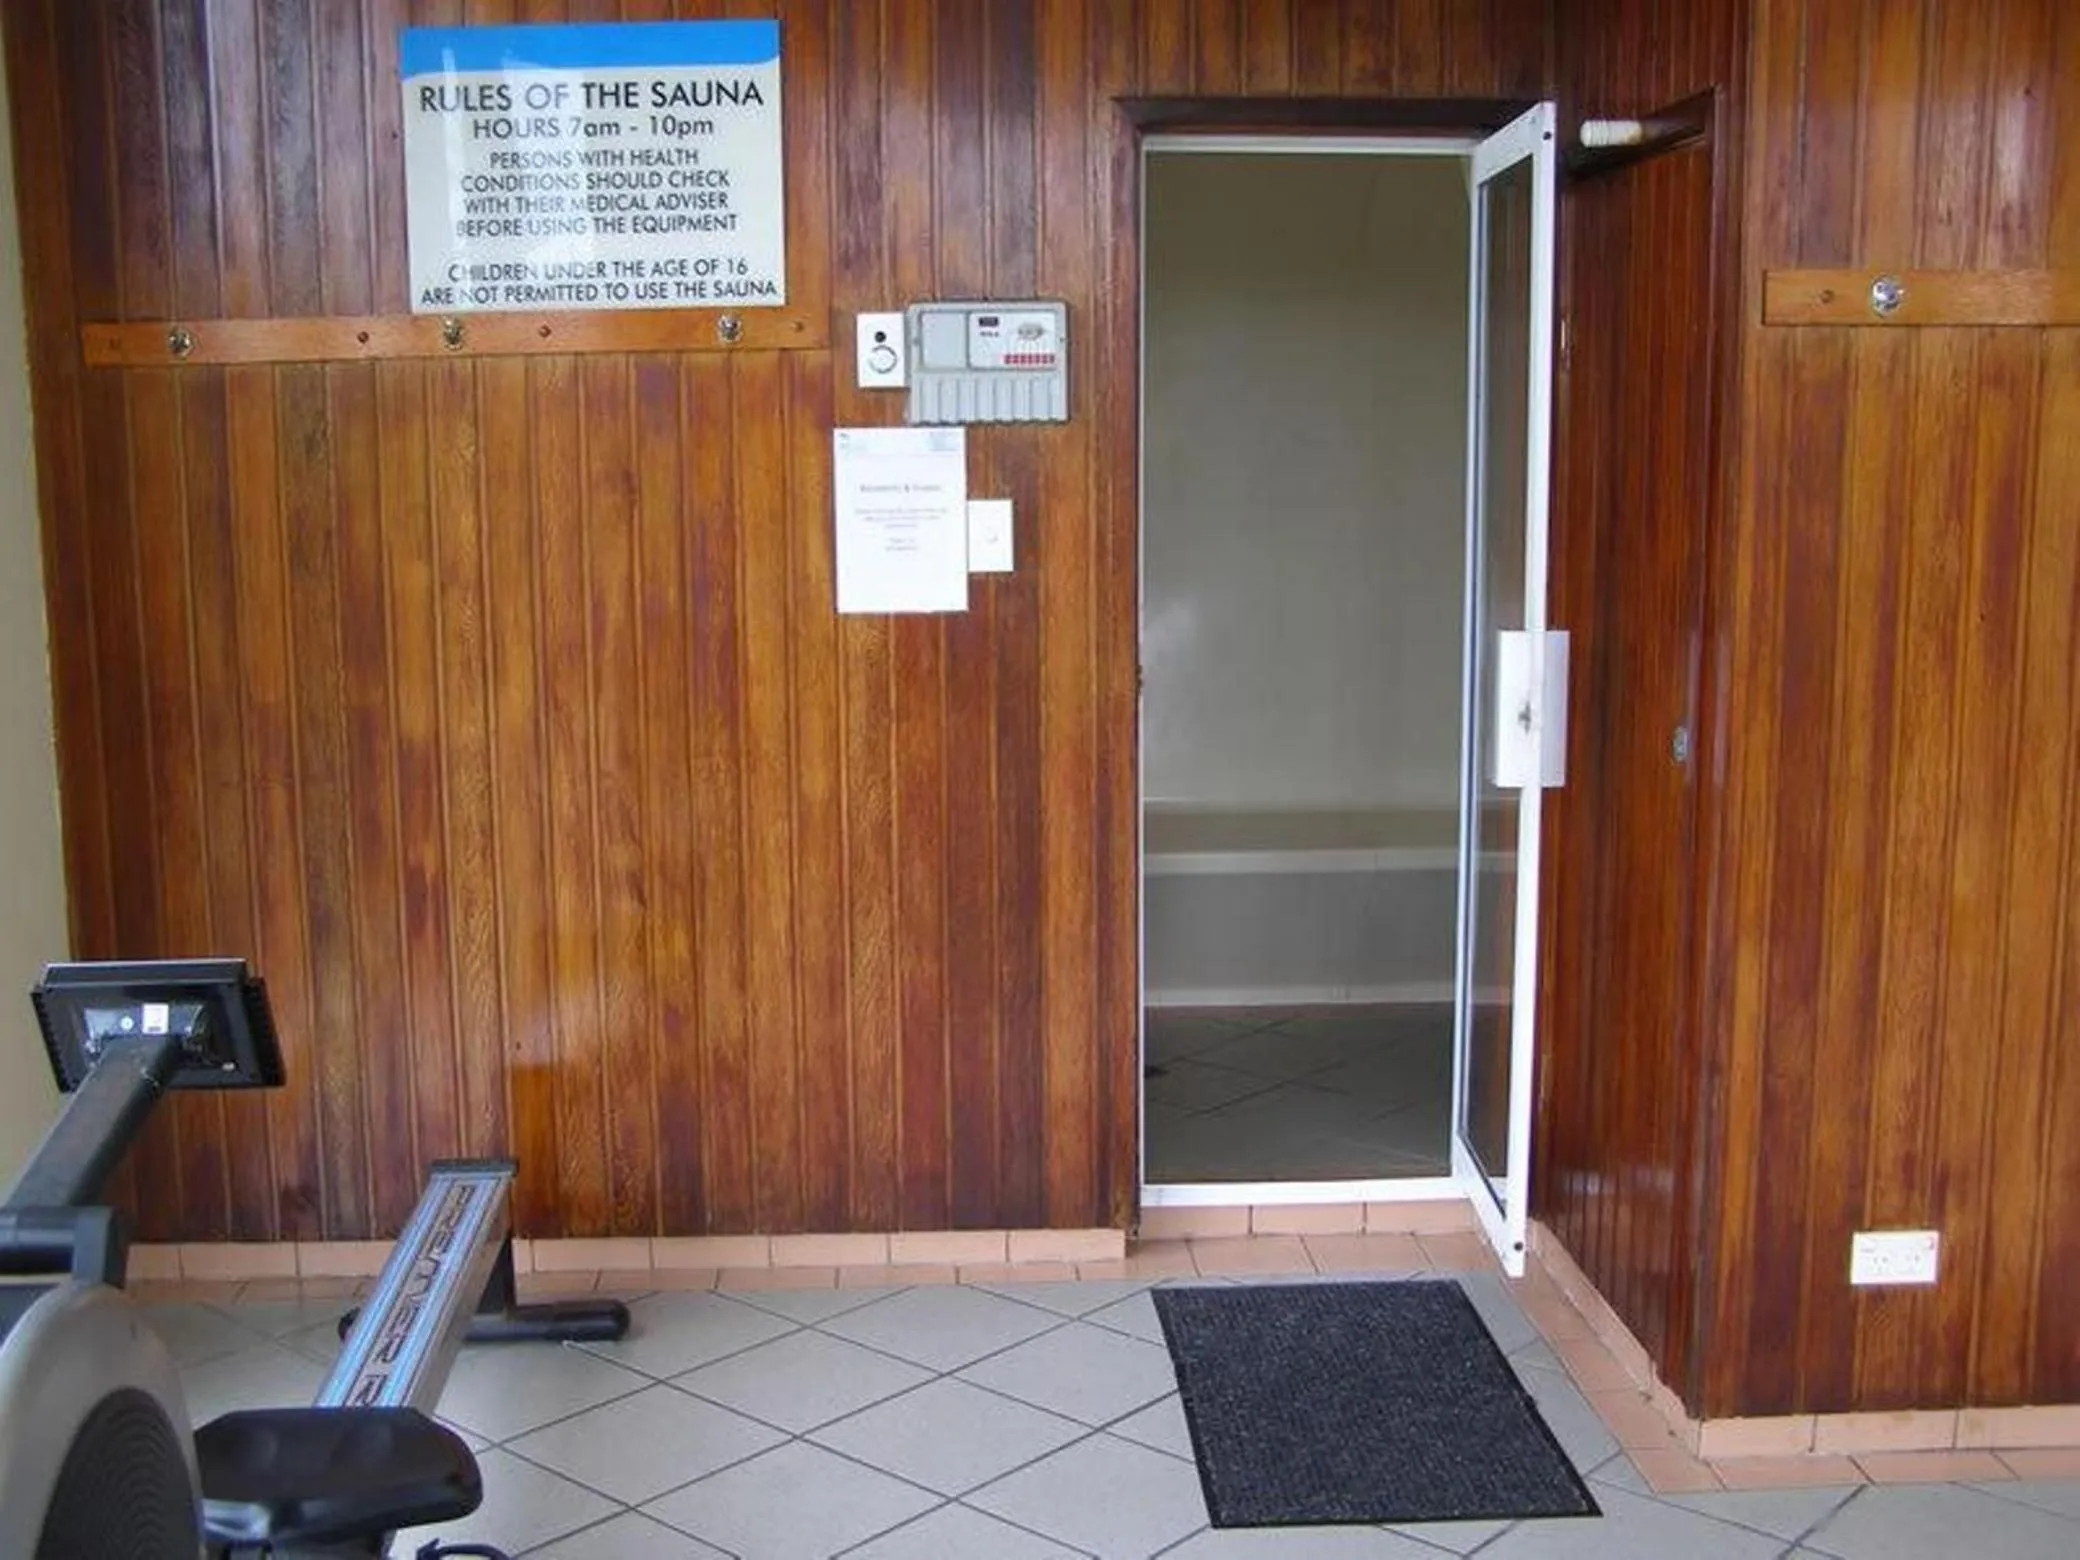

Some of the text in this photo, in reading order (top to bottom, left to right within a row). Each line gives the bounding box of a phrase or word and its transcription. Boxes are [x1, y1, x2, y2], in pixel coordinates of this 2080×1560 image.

[420, 79, 764, 112] RULES OF THE SAUNA
[473, 117, 560, 139] HOURS
[569, 116, 620, 138] 7am
[650, 114, 713, 139] 10pm
[490, 148, 698, 169] PERSONS WITH HEALTH
[461, 169, 730, 193] CONDITIONS SHOULD CHECK
[464, 191, 729, 214] WITH THEIR MEDICAL ADVISER
[456, 213, 737, 237] BEFORE USING THE EQUIPMENT
[544, 261, 606, 279] UNDER
[613, 260, 645, 278] THE
[651, 258, 688, 277] AGE
[694, 258, 720, 276] OF
[728, 257, 748, 275] 16
[421, 279, 778, 304] ARE NOT PERMITTED TO USE THE SAUNA
